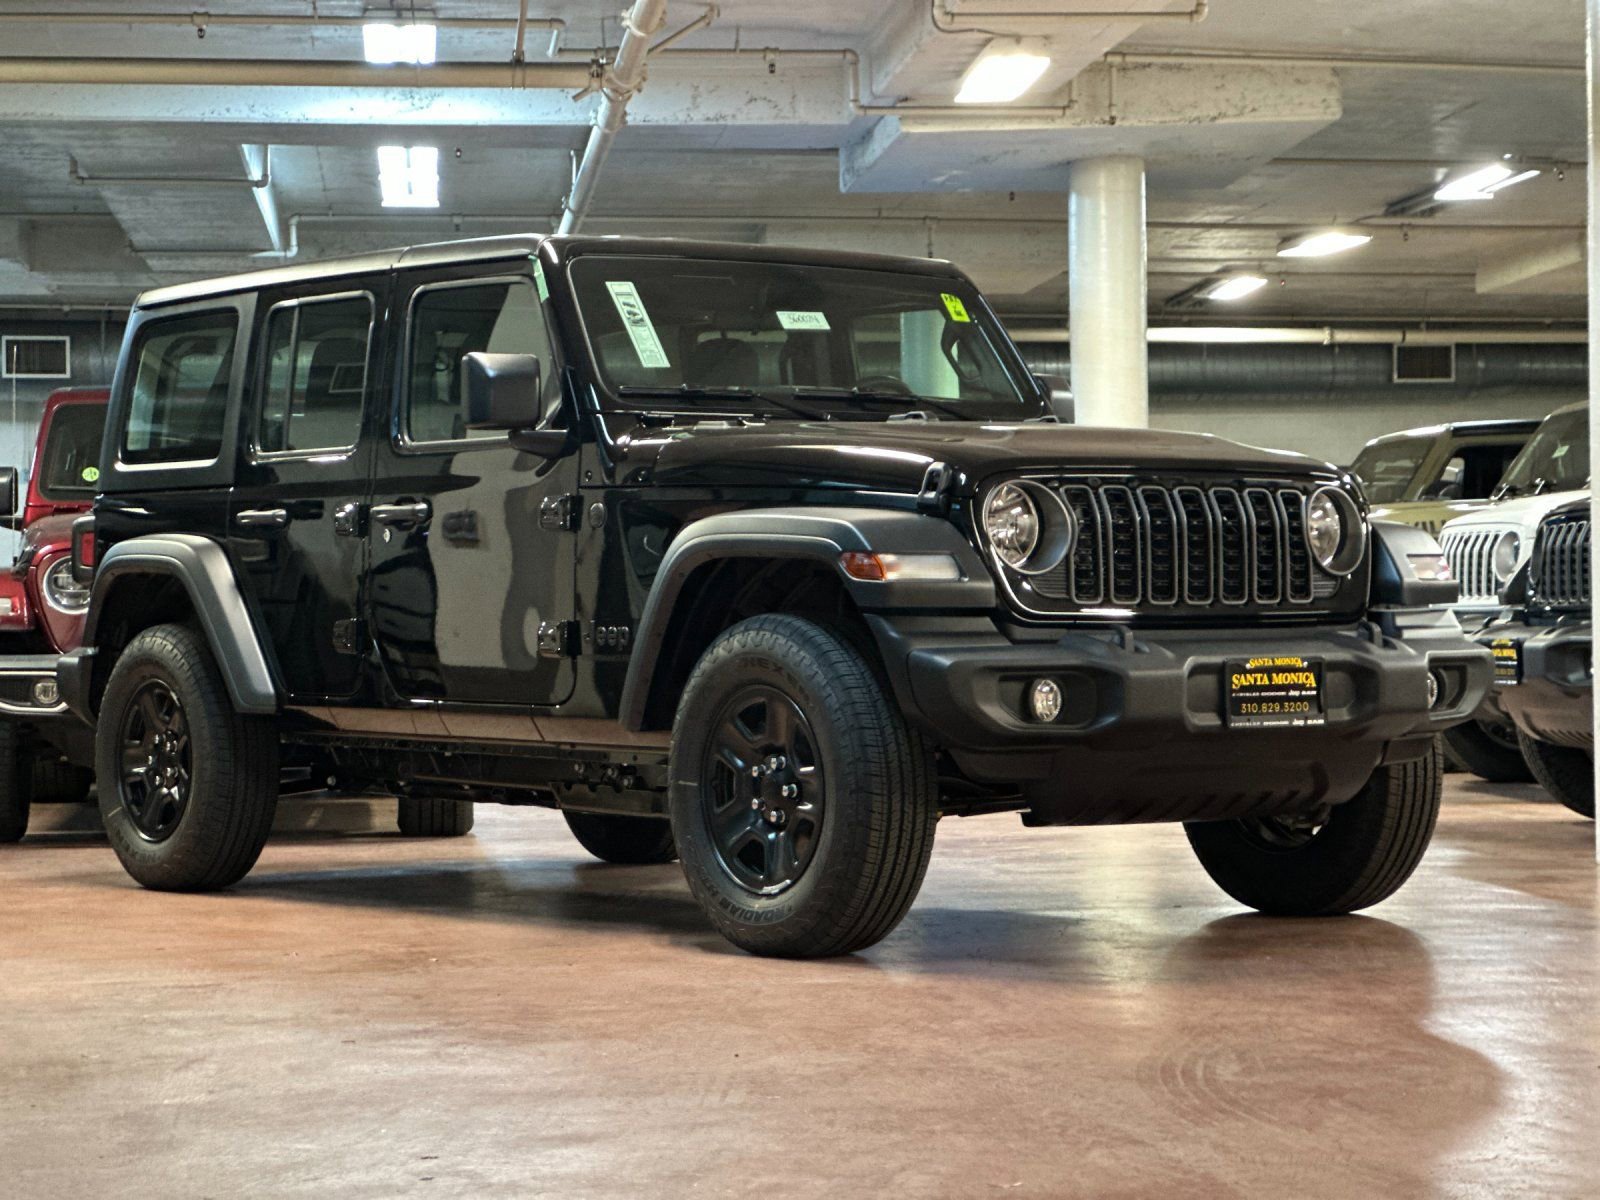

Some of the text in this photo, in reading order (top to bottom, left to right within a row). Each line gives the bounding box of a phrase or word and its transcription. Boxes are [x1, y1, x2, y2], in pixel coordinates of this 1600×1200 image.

[583, 620, 629, 652] Jeep
[1249, 656, 1303, 669] SANTA MONICA
[1231, 672, 1317, 689] SANTA MONICA
[1240, 702, 1310, 714] 310.829.3200
